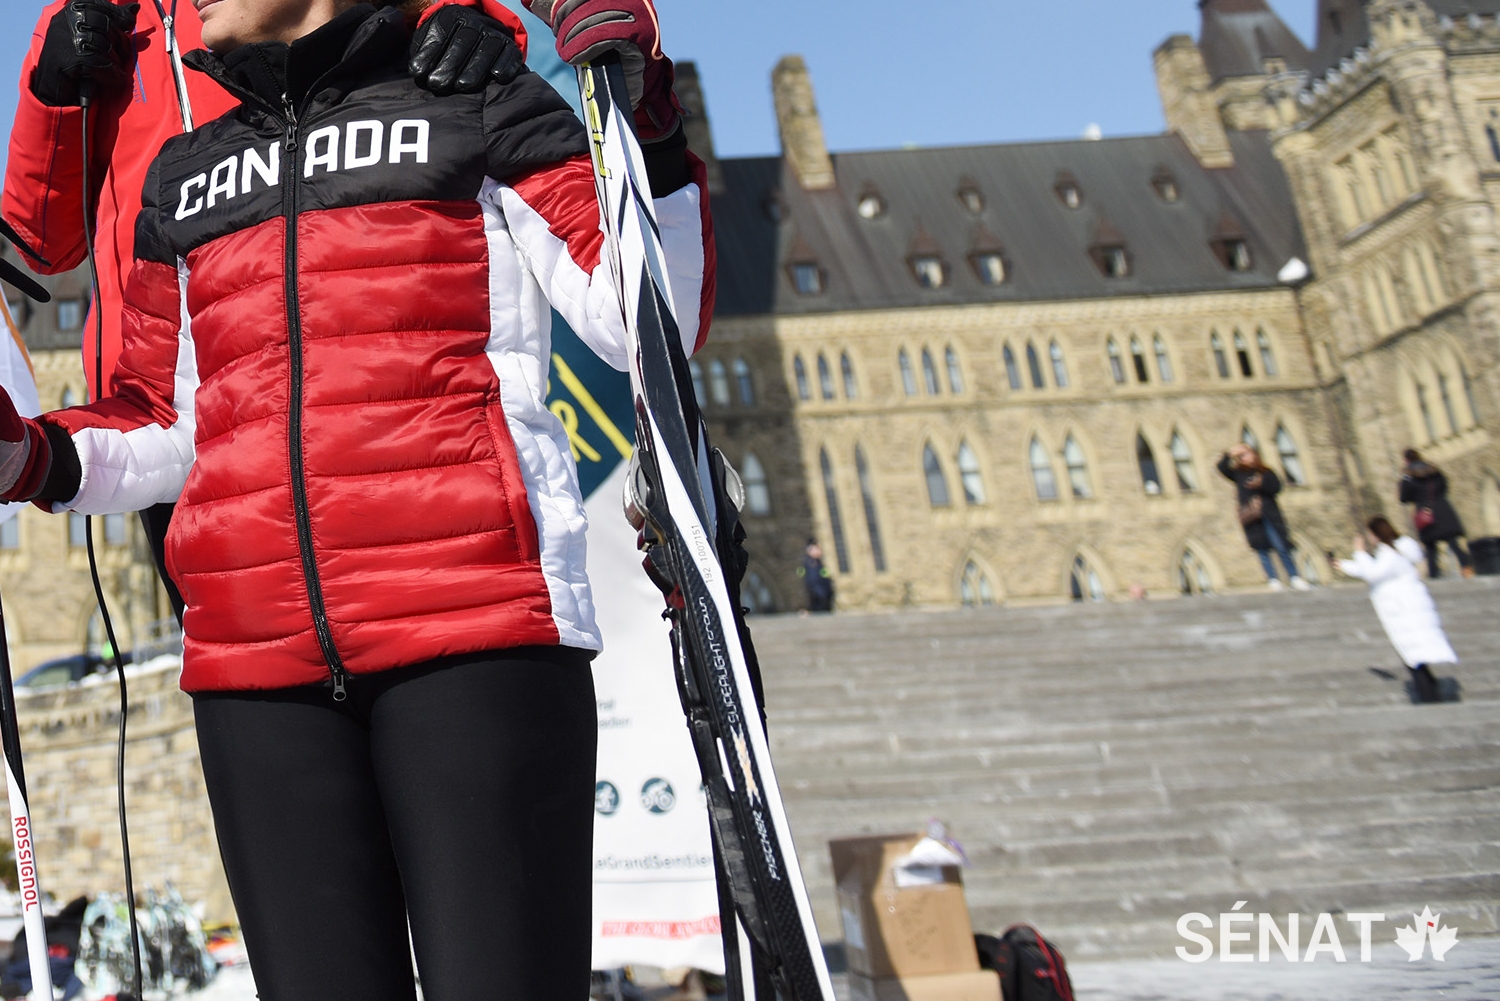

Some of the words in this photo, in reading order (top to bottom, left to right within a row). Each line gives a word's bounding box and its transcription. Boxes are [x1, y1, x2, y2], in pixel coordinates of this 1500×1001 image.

[174, 118, 430, 221] CANADA
[709, 642, 740, 724] SUPERLIGHT
[14, 815, 38, 912] ROSSIGNOL
[594, 852, 714, 872] eGrandSentie
[753, 810, 781, 881] FISCHER
